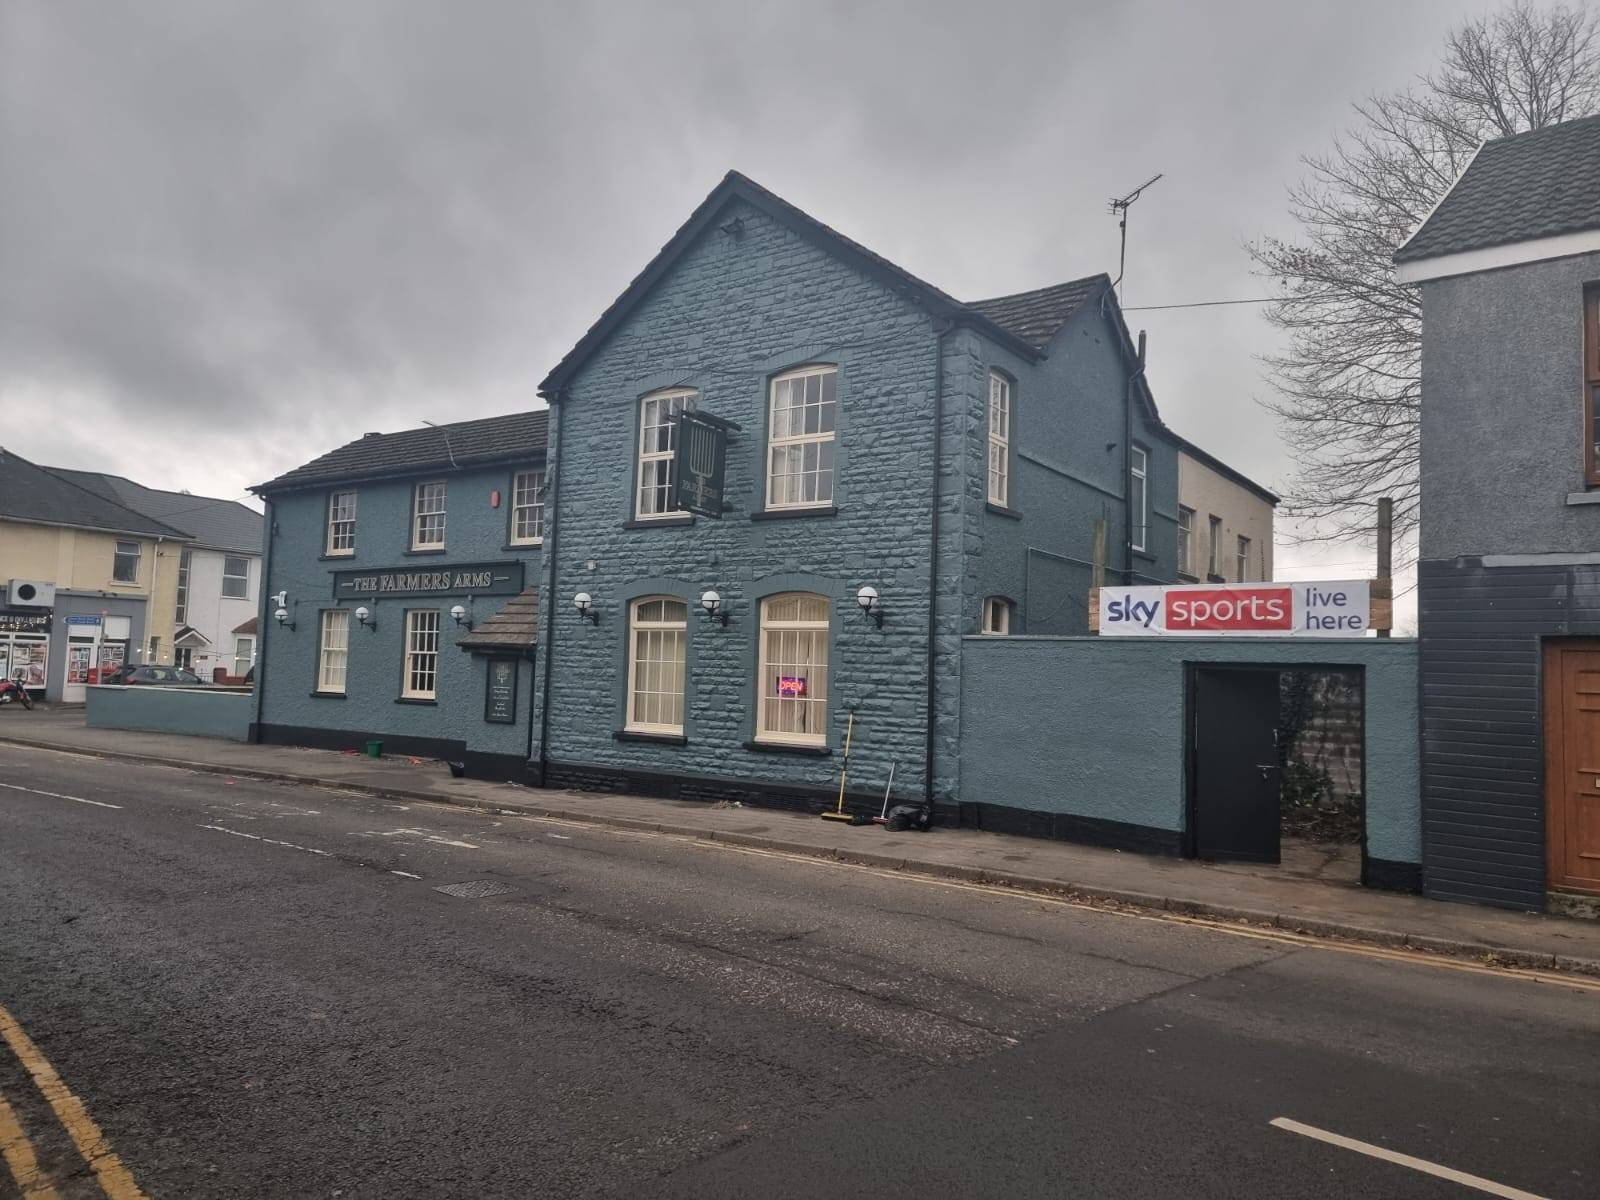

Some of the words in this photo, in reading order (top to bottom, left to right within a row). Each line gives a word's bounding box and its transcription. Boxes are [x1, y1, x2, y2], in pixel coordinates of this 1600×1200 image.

[353, 577, 377, 591] THE
[379, 572, 451, 592] FARMERS
[453, 571, 492, 588] ARMS
[1305, 588, 1348, 607] live
[1107, 594, 1161, 628] sky
[1171, 595, 1285, 627] sports
[1305, 611, 1362, 630] here
[779, 681, 803, 691] OPEN
